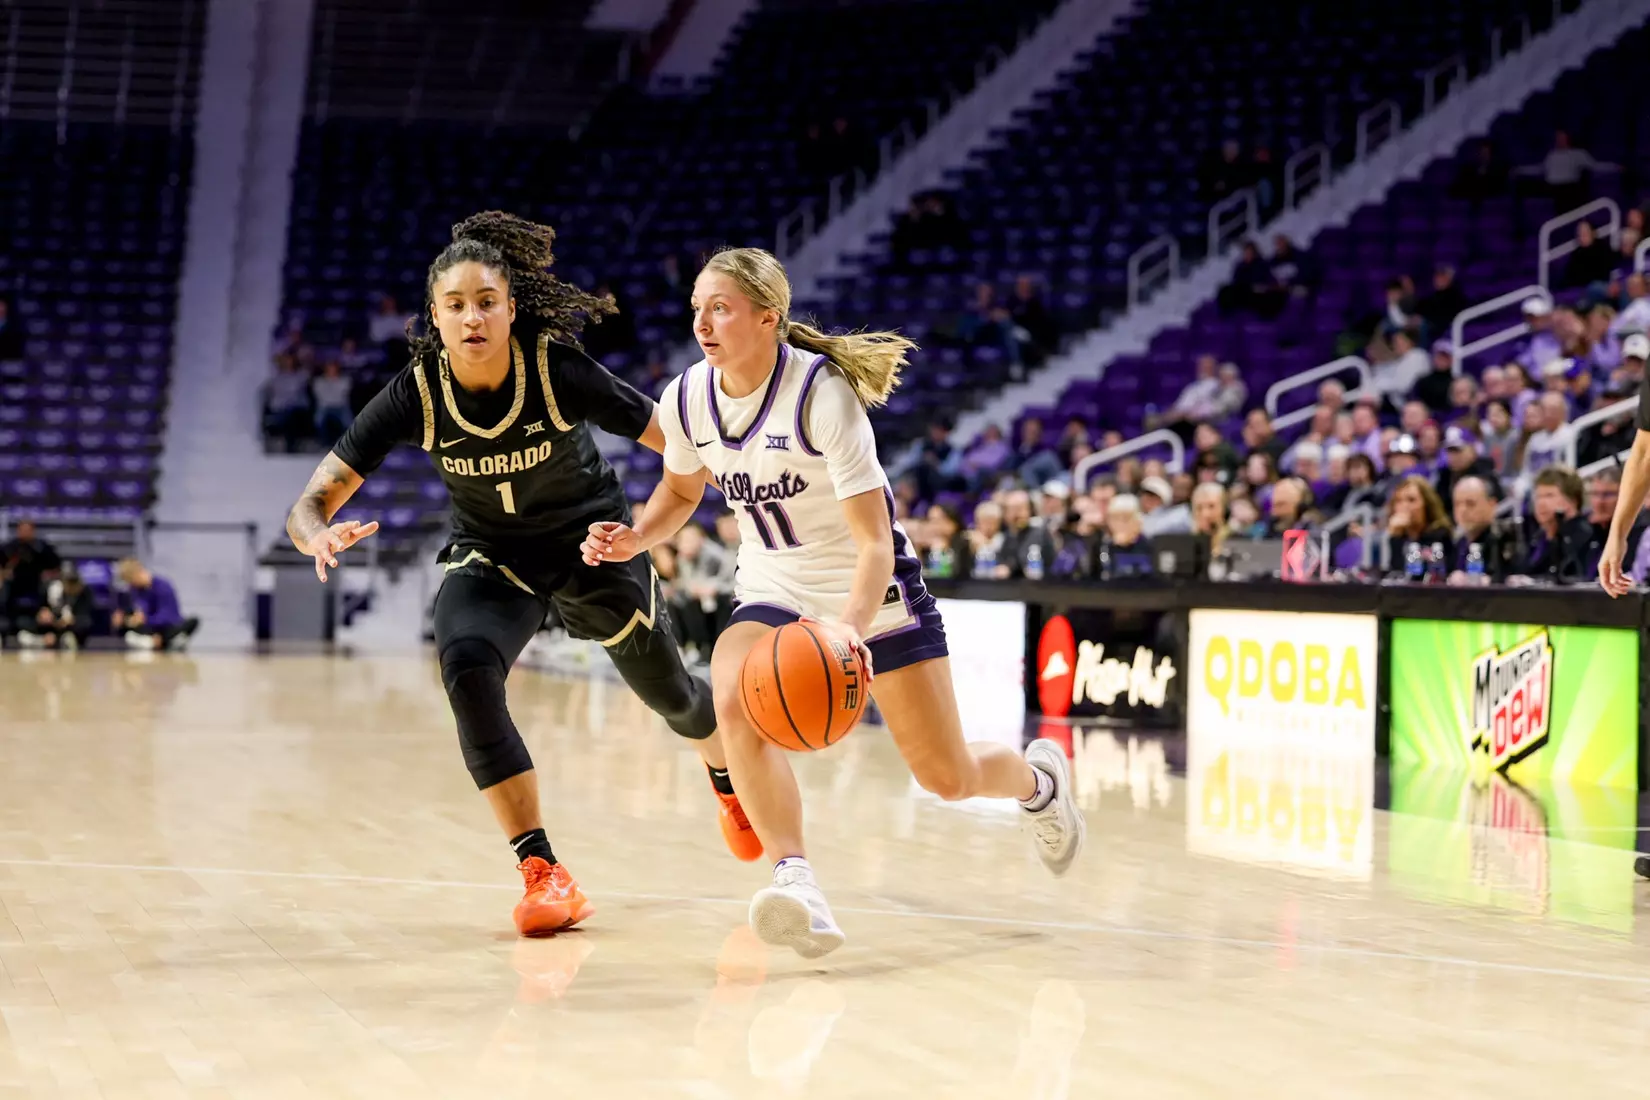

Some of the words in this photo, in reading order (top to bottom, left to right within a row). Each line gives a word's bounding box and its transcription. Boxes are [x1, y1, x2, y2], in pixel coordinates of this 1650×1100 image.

[441, 440, 552, 477] COLORADO
[765, 433, 790, 451] XII
[495, 481, 516, 514] 1
[743, 502, 803, 551] 11
[1204, 635, 1366, 718] QDOBA
